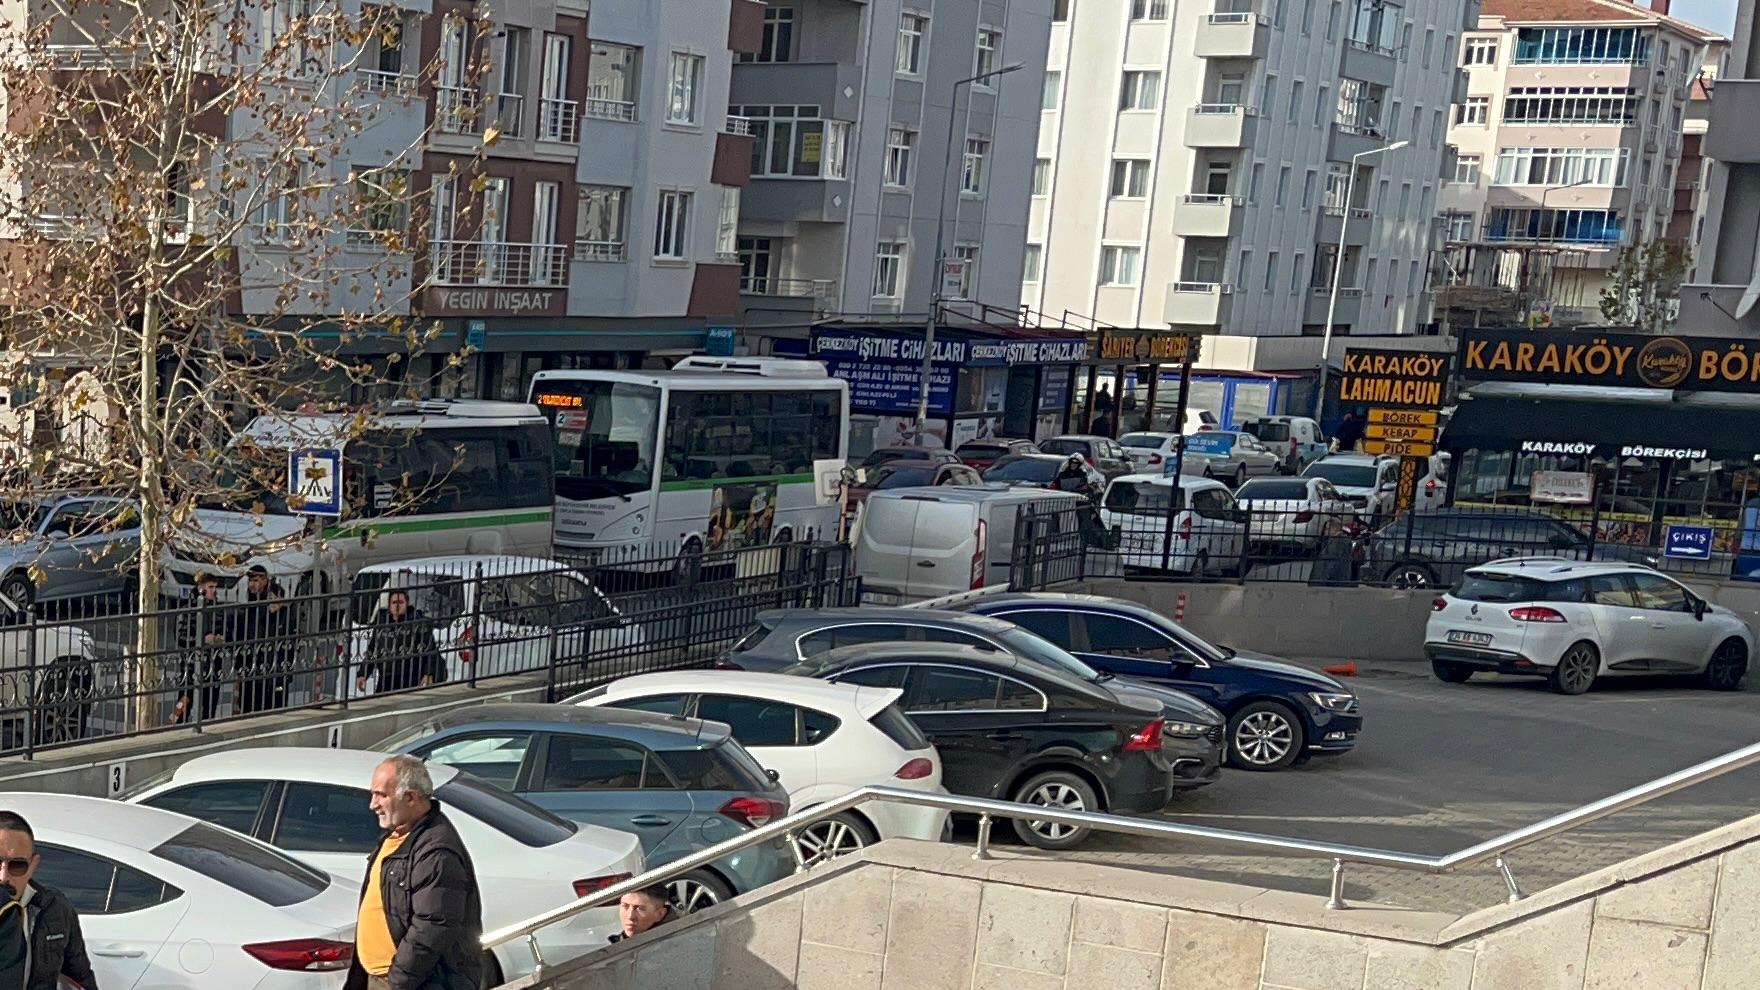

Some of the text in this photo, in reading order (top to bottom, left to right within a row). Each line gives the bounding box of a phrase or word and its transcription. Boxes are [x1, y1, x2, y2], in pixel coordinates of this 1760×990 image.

[858, 336, 899, 361] İŞİTME
[1006, 341, 1038, 366] İŞİTME
[1466, 338, 1634, 376] KARAKÖY
[1343, 353, 1444, 377] KARAKÖY
[1341, 376, 1441, 406] LAHMACUN
[1522, 441, 1707, 460] KARAKÖY BÖREKÇİSİ
[1672, 532, 1707, 545] ÇIKIŞ
[331, 727, 339, 748] 4
[113, 766, 121, 792] 3
